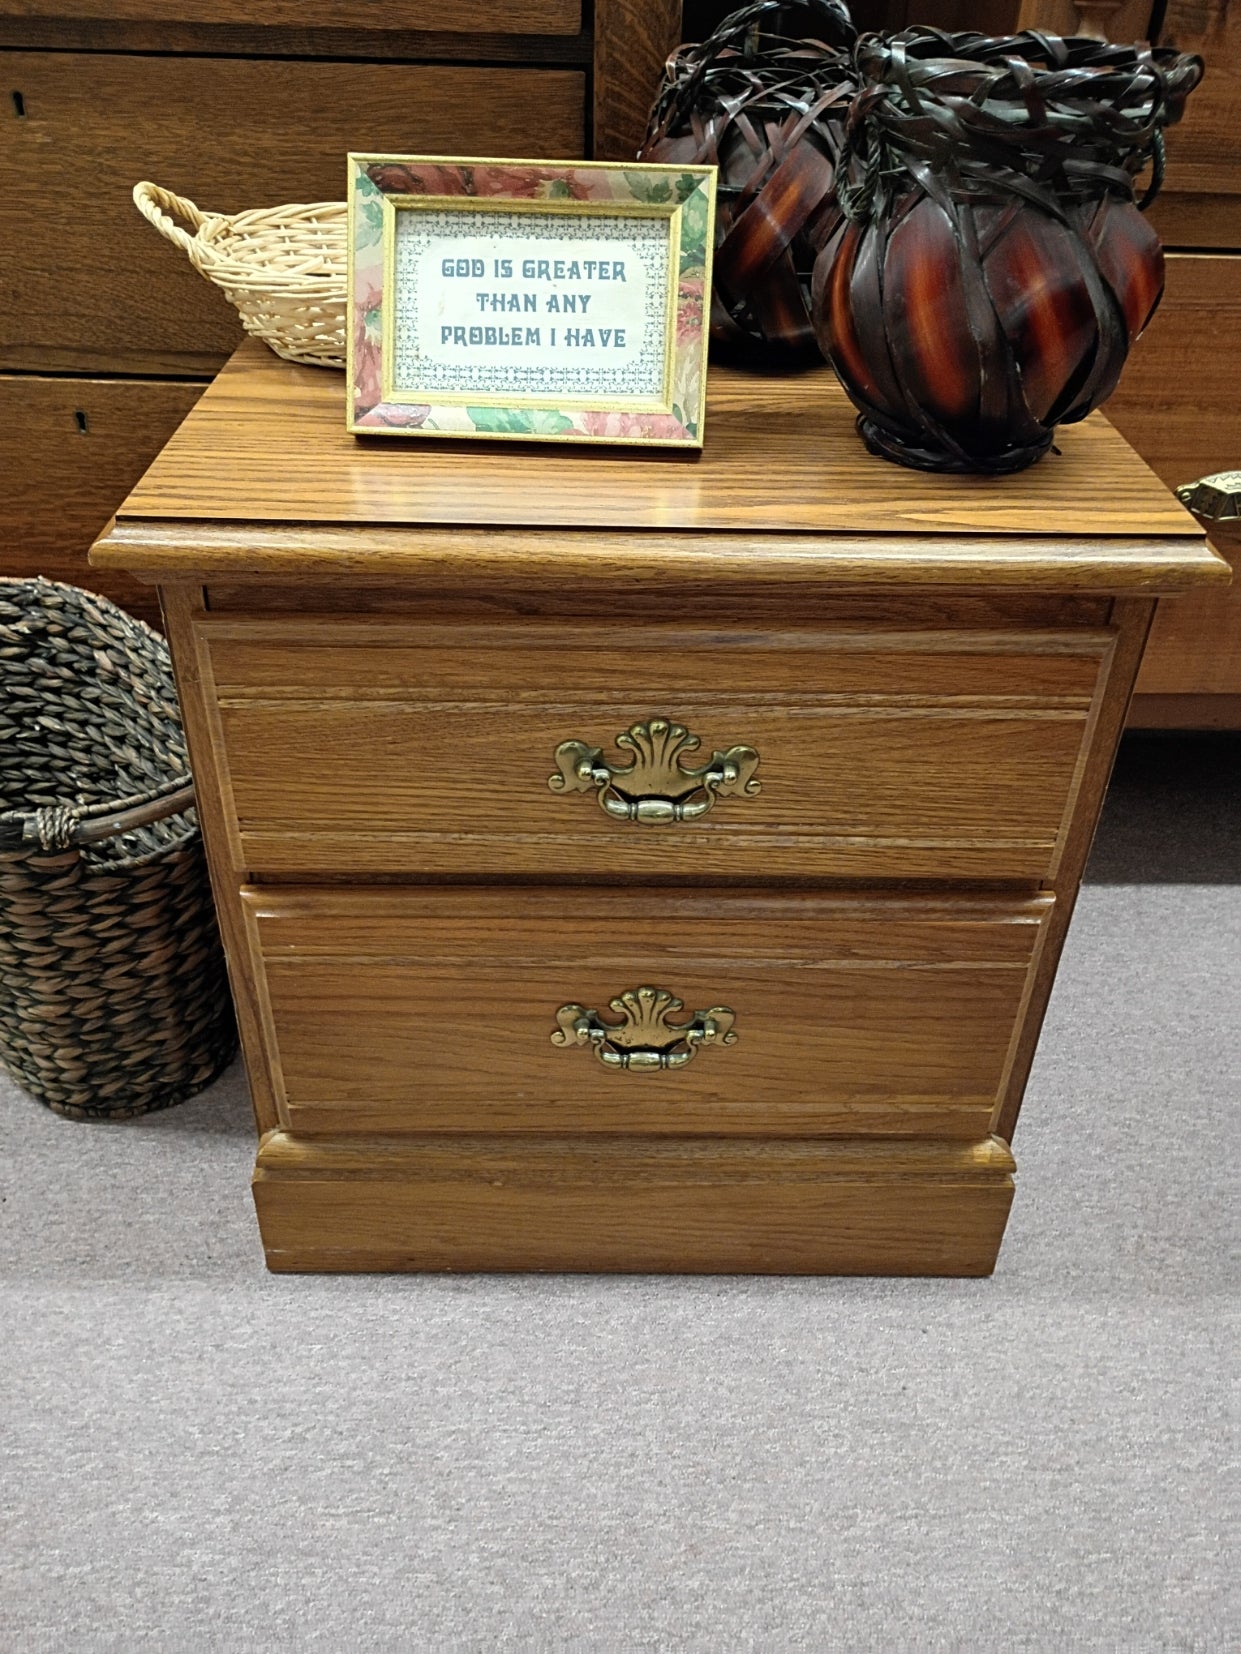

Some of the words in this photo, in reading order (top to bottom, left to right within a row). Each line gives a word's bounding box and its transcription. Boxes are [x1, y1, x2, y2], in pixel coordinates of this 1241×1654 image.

[441, 259, 485, 278] GOD
[494, 259, 513, 278] IS
[522, 260, 627, 282] GREATER
[476, 293, 537, 312] THAN
[546, 294, 592, 313] ANY
[441, 326, 541, 347] PROBLEM
[550, 328, 556, 347] I
[564, 328, 626, 348] HAVE
